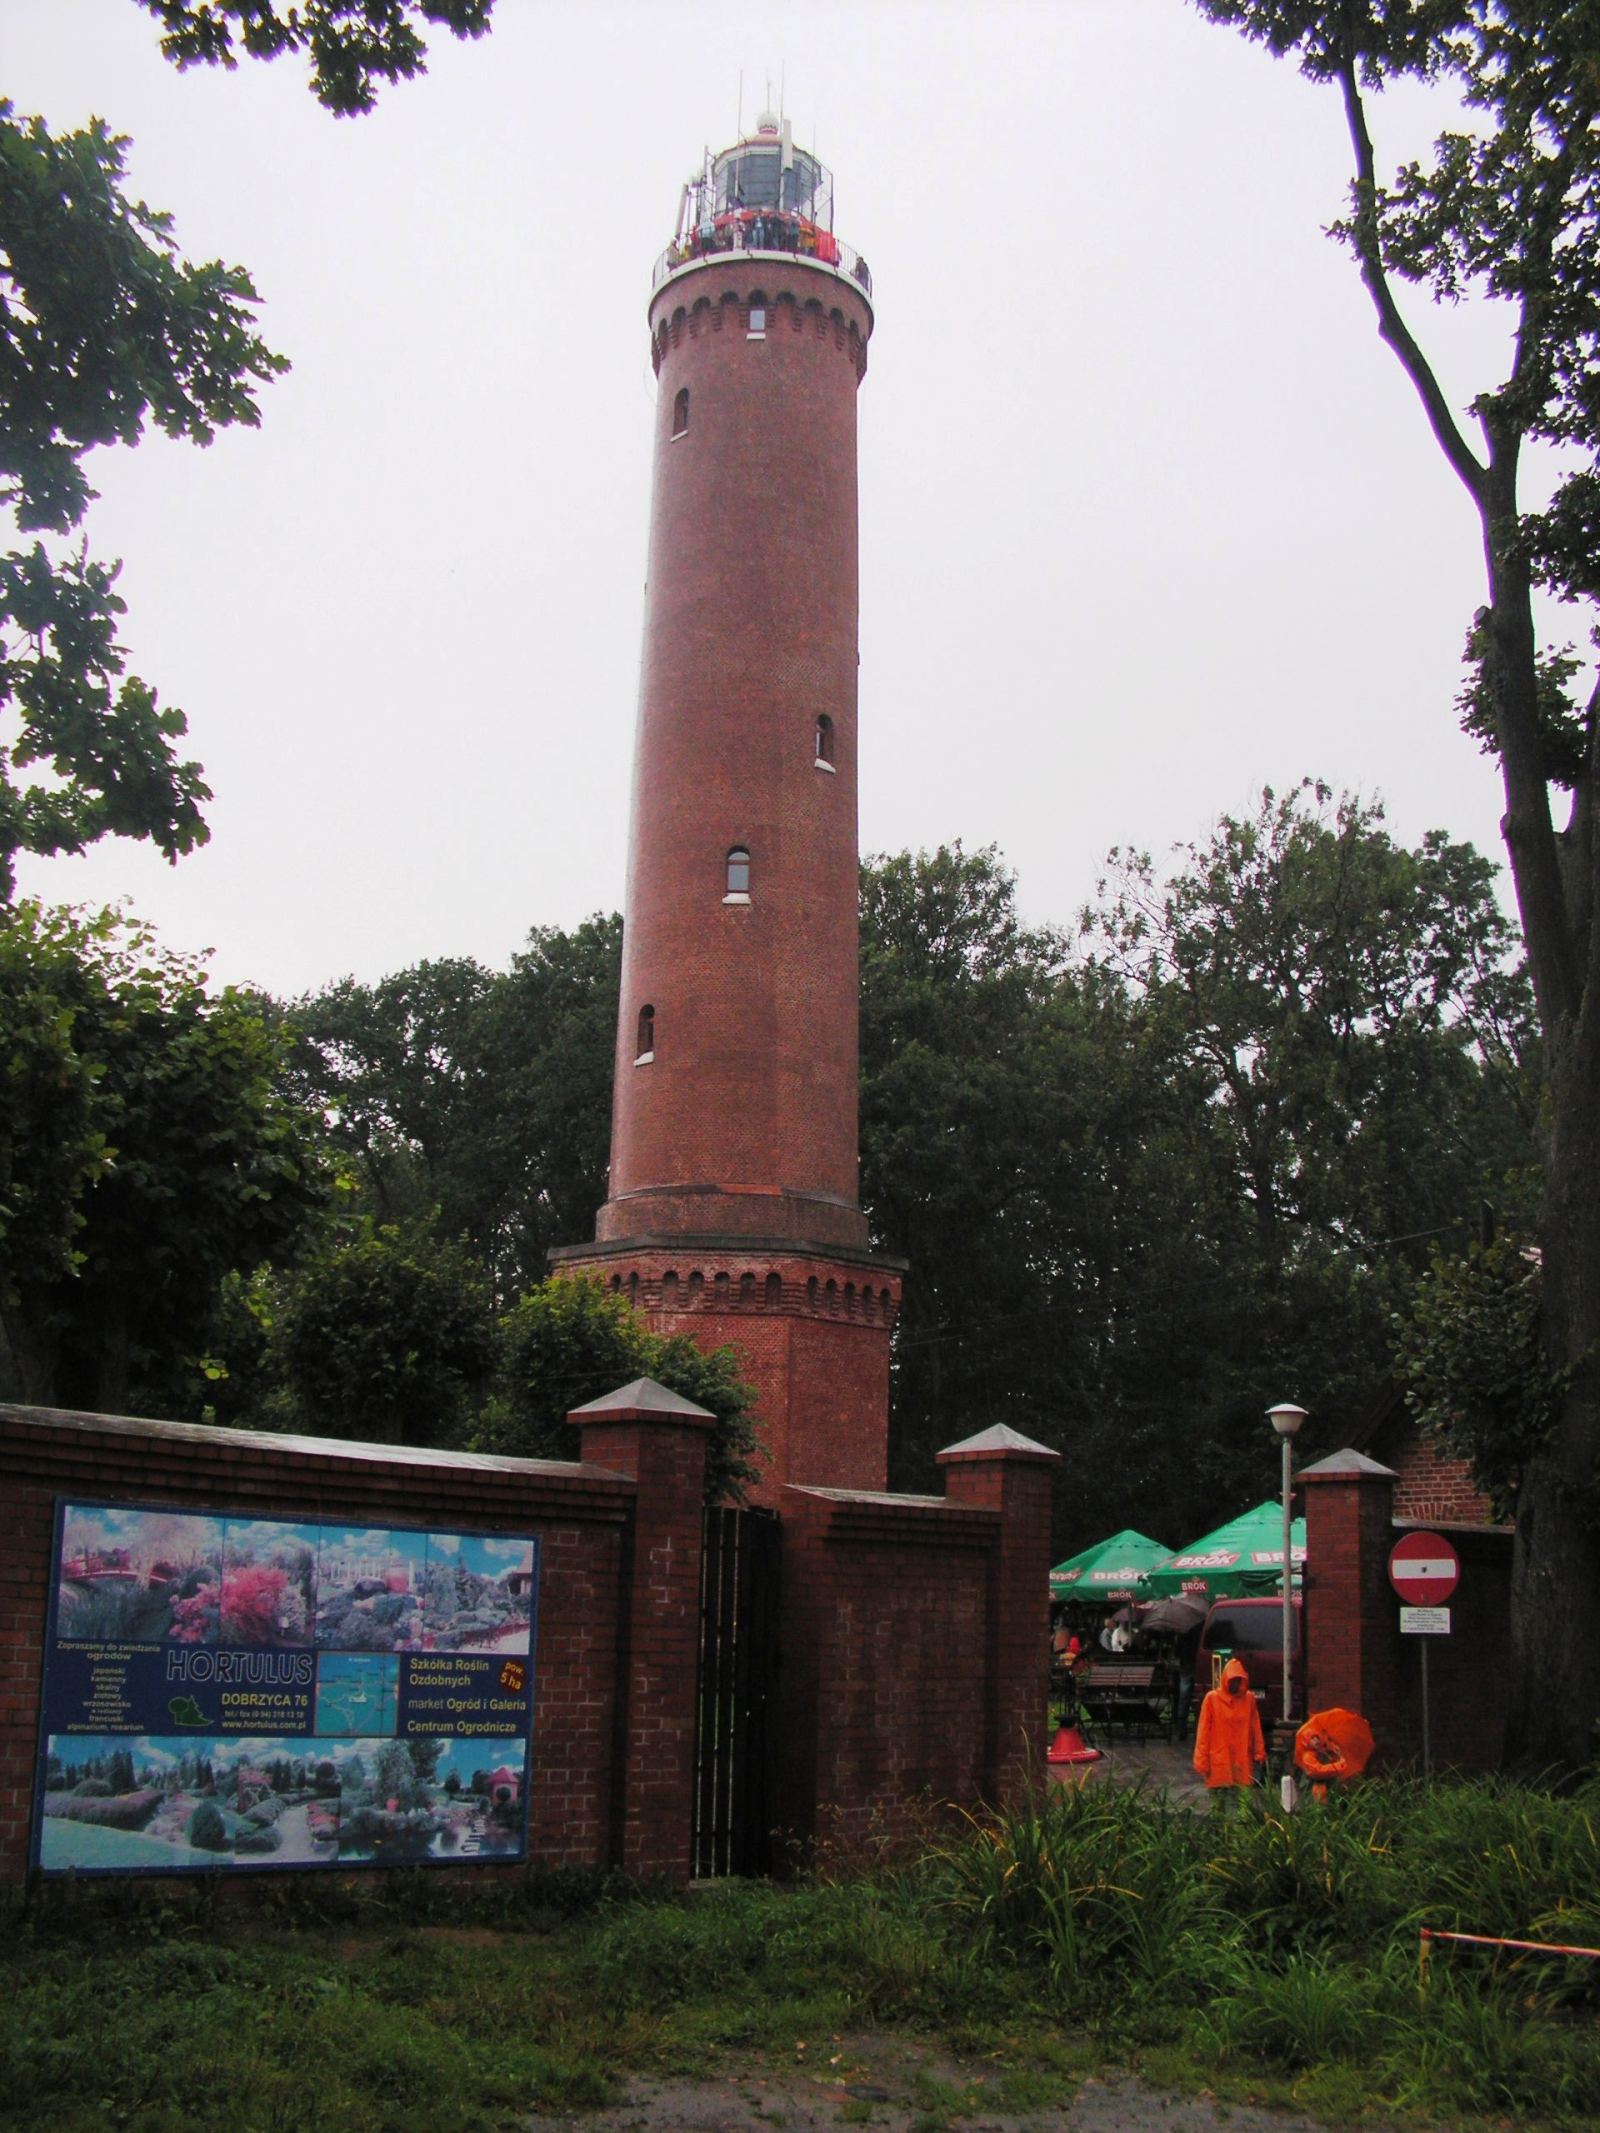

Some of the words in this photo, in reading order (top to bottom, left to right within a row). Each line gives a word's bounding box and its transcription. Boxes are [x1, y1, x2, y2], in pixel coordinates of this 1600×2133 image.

[1176, 1555, 1234, 1567] BROK
[1256, 1552, 1306, 1562] BRO
[1181, 1582, 1207, 1591] BROK
[1107, 1591, 1133, 1599] BROK
[57, 1641, 105, 1653] Zapraszamy
[106, 1643, 118, 1651] do
[119, 1645, 161, 1653] zwiedzania
[166, 1649, 313, 1685] HORTULUS
[409, 1657, 453, 1671] Szkółka
[455, 1659, 490, 1672] Roślin
[504, 1661, 525, 1677] pow.
[409, 1673, 472, 1689] Ozdobnych
[499, 1671, 507, 1684] 5
[508, 1675, 523, 1690] ha
[221, 1692, 292, 1706] DOBRZYCA
[294, 1694, 309, 1706] 76
[407, 1698, 444, 1710] market
[446, 1697, 482, 1712] Ogród
[489, 1697, 527, 1711] Galeria
[239, 1710, 251, 1719] fax
[221, 1720, 307, 1730] www.hortulus.com.pl
[407, 1719, 454, 1732] Centrum
[456, 1720, 518, 1735] Ogrodnicze
